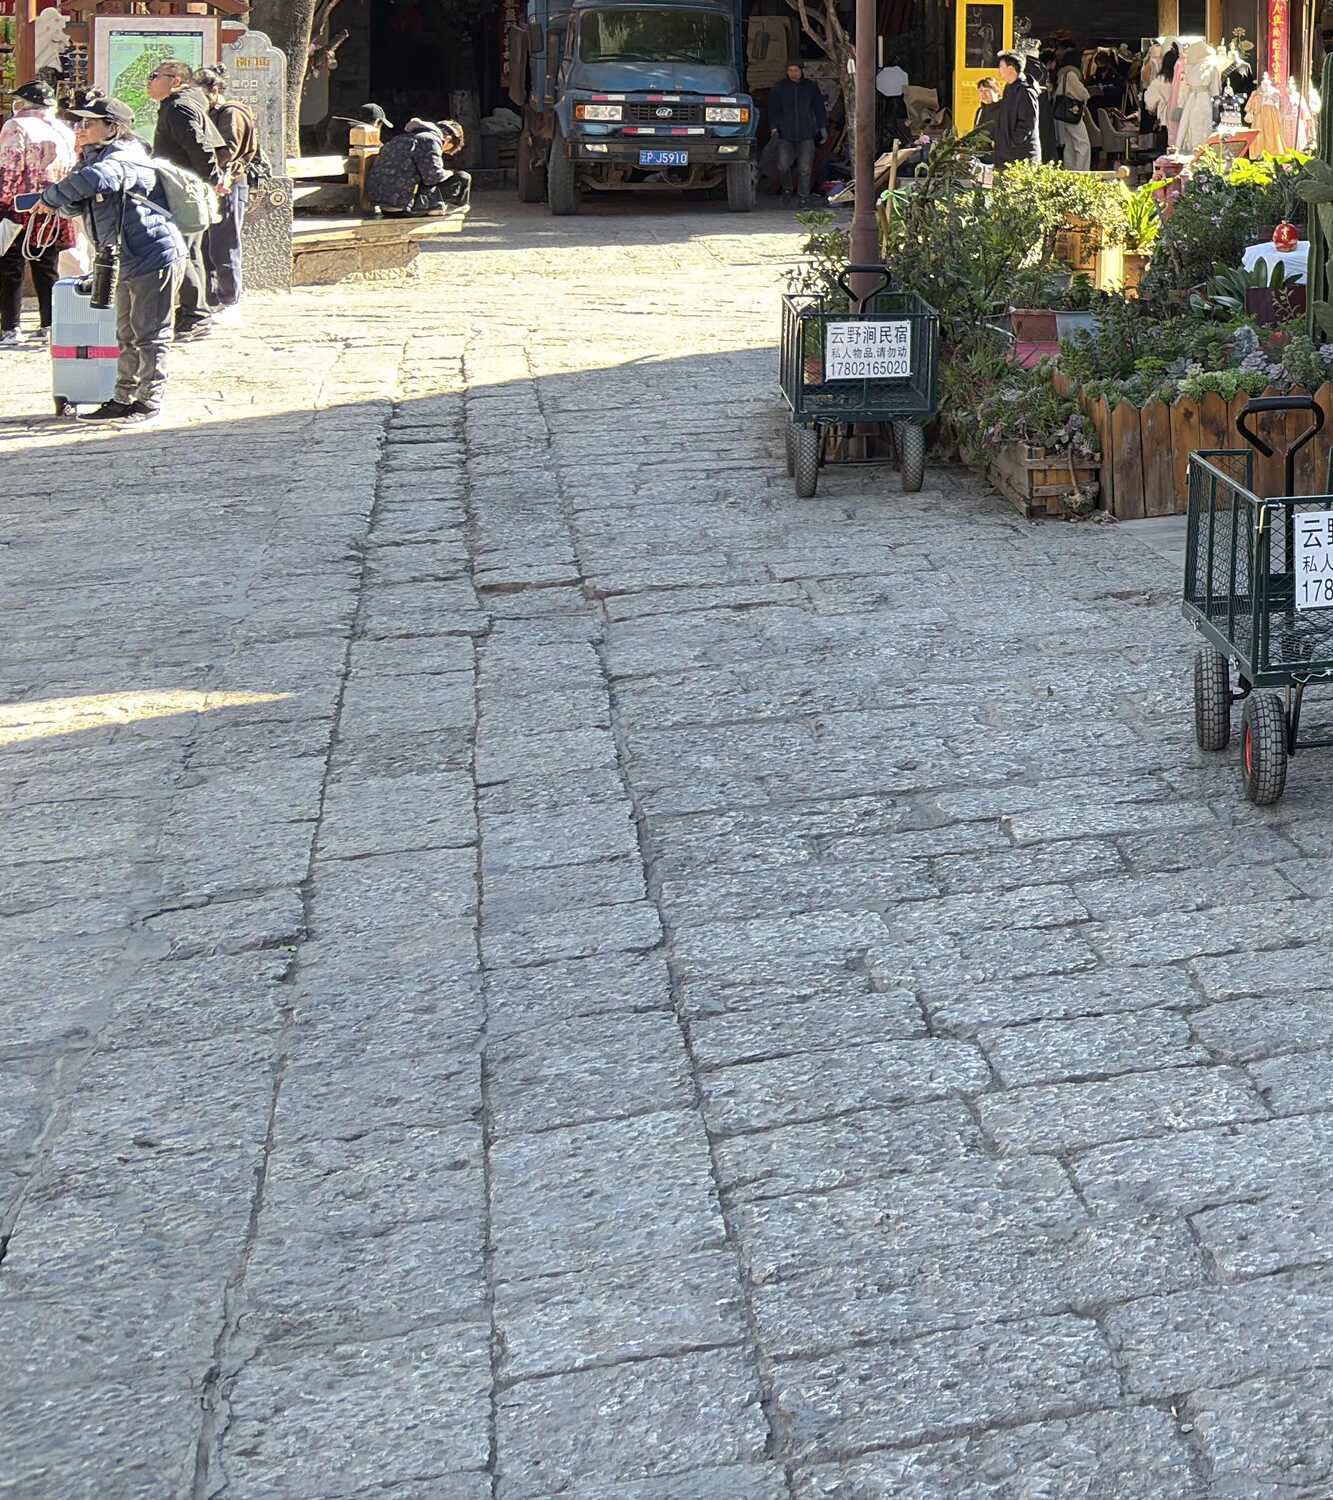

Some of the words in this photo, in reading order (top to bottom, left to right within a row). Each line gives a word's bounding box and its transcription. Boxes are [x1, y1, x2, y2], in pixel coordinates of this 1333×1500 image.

[236, 56, 270, 69] 南门街
[830, 325, 908, 345] 云野涧民宿
[831, 346, 907, 359] 私人物品,请勿动
[830, 360, 908, 376] 17802165020
